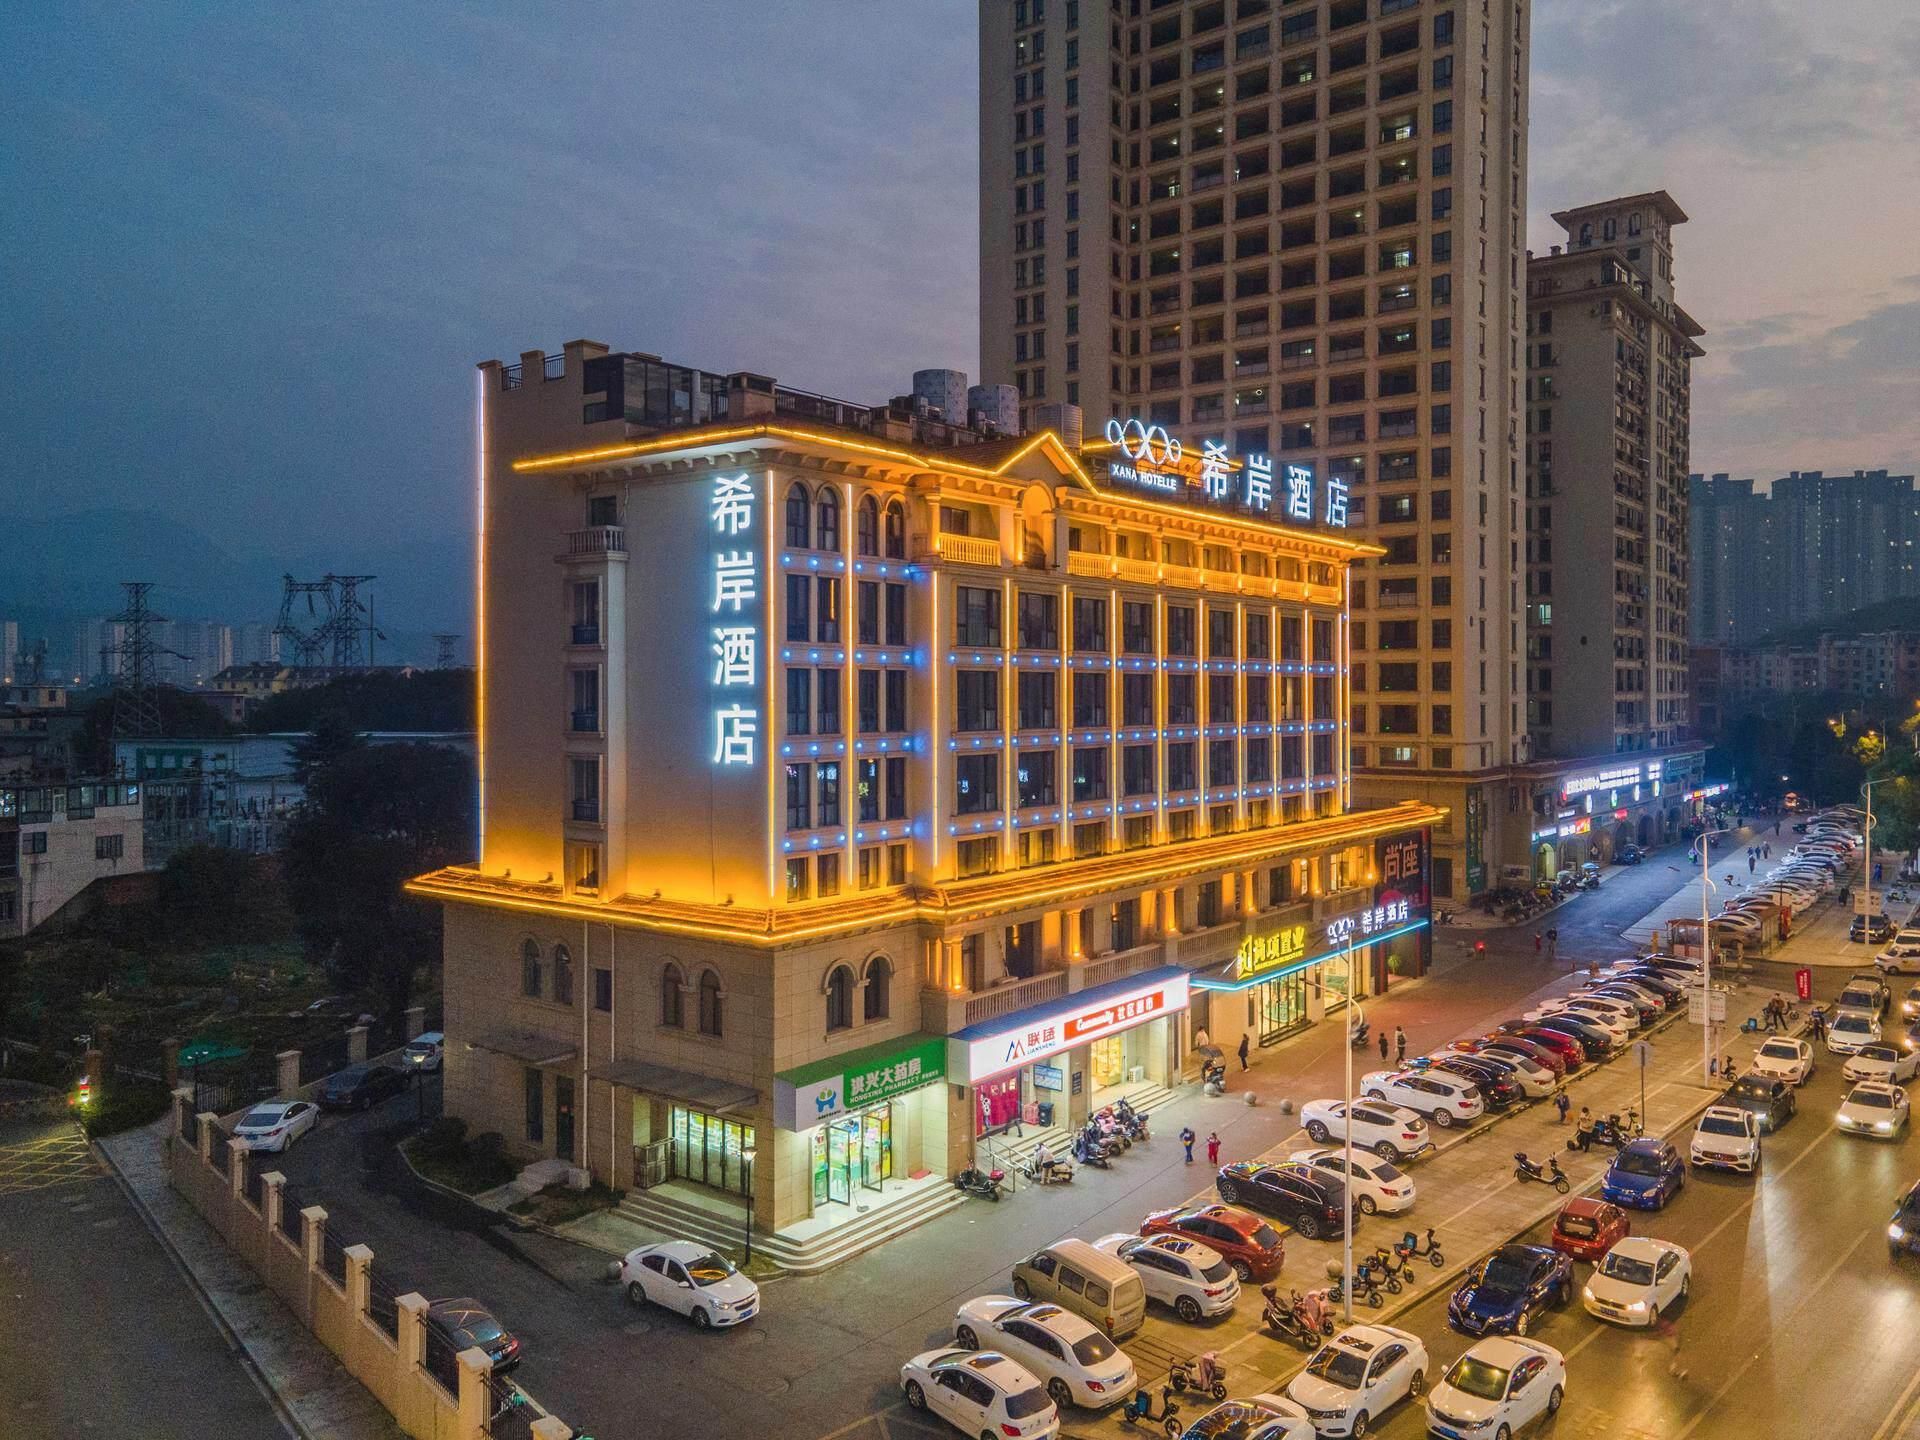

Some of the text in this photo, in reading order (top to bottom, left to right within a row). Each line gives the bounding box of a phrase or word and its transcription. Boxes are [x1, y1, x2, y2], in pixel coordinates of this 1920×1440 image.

[1112, 464, 1177, 490] XANA HOTELLE
[1202, 440, 1349, 528] 希岸酒店
[712, 472, 757, 766] 希岸酒店
[1384, 840, 1419, 883] 尚座
[849, 1088, 883, 1104] HONGXING
[884, 1076, 920, 1093] PHARMACY
